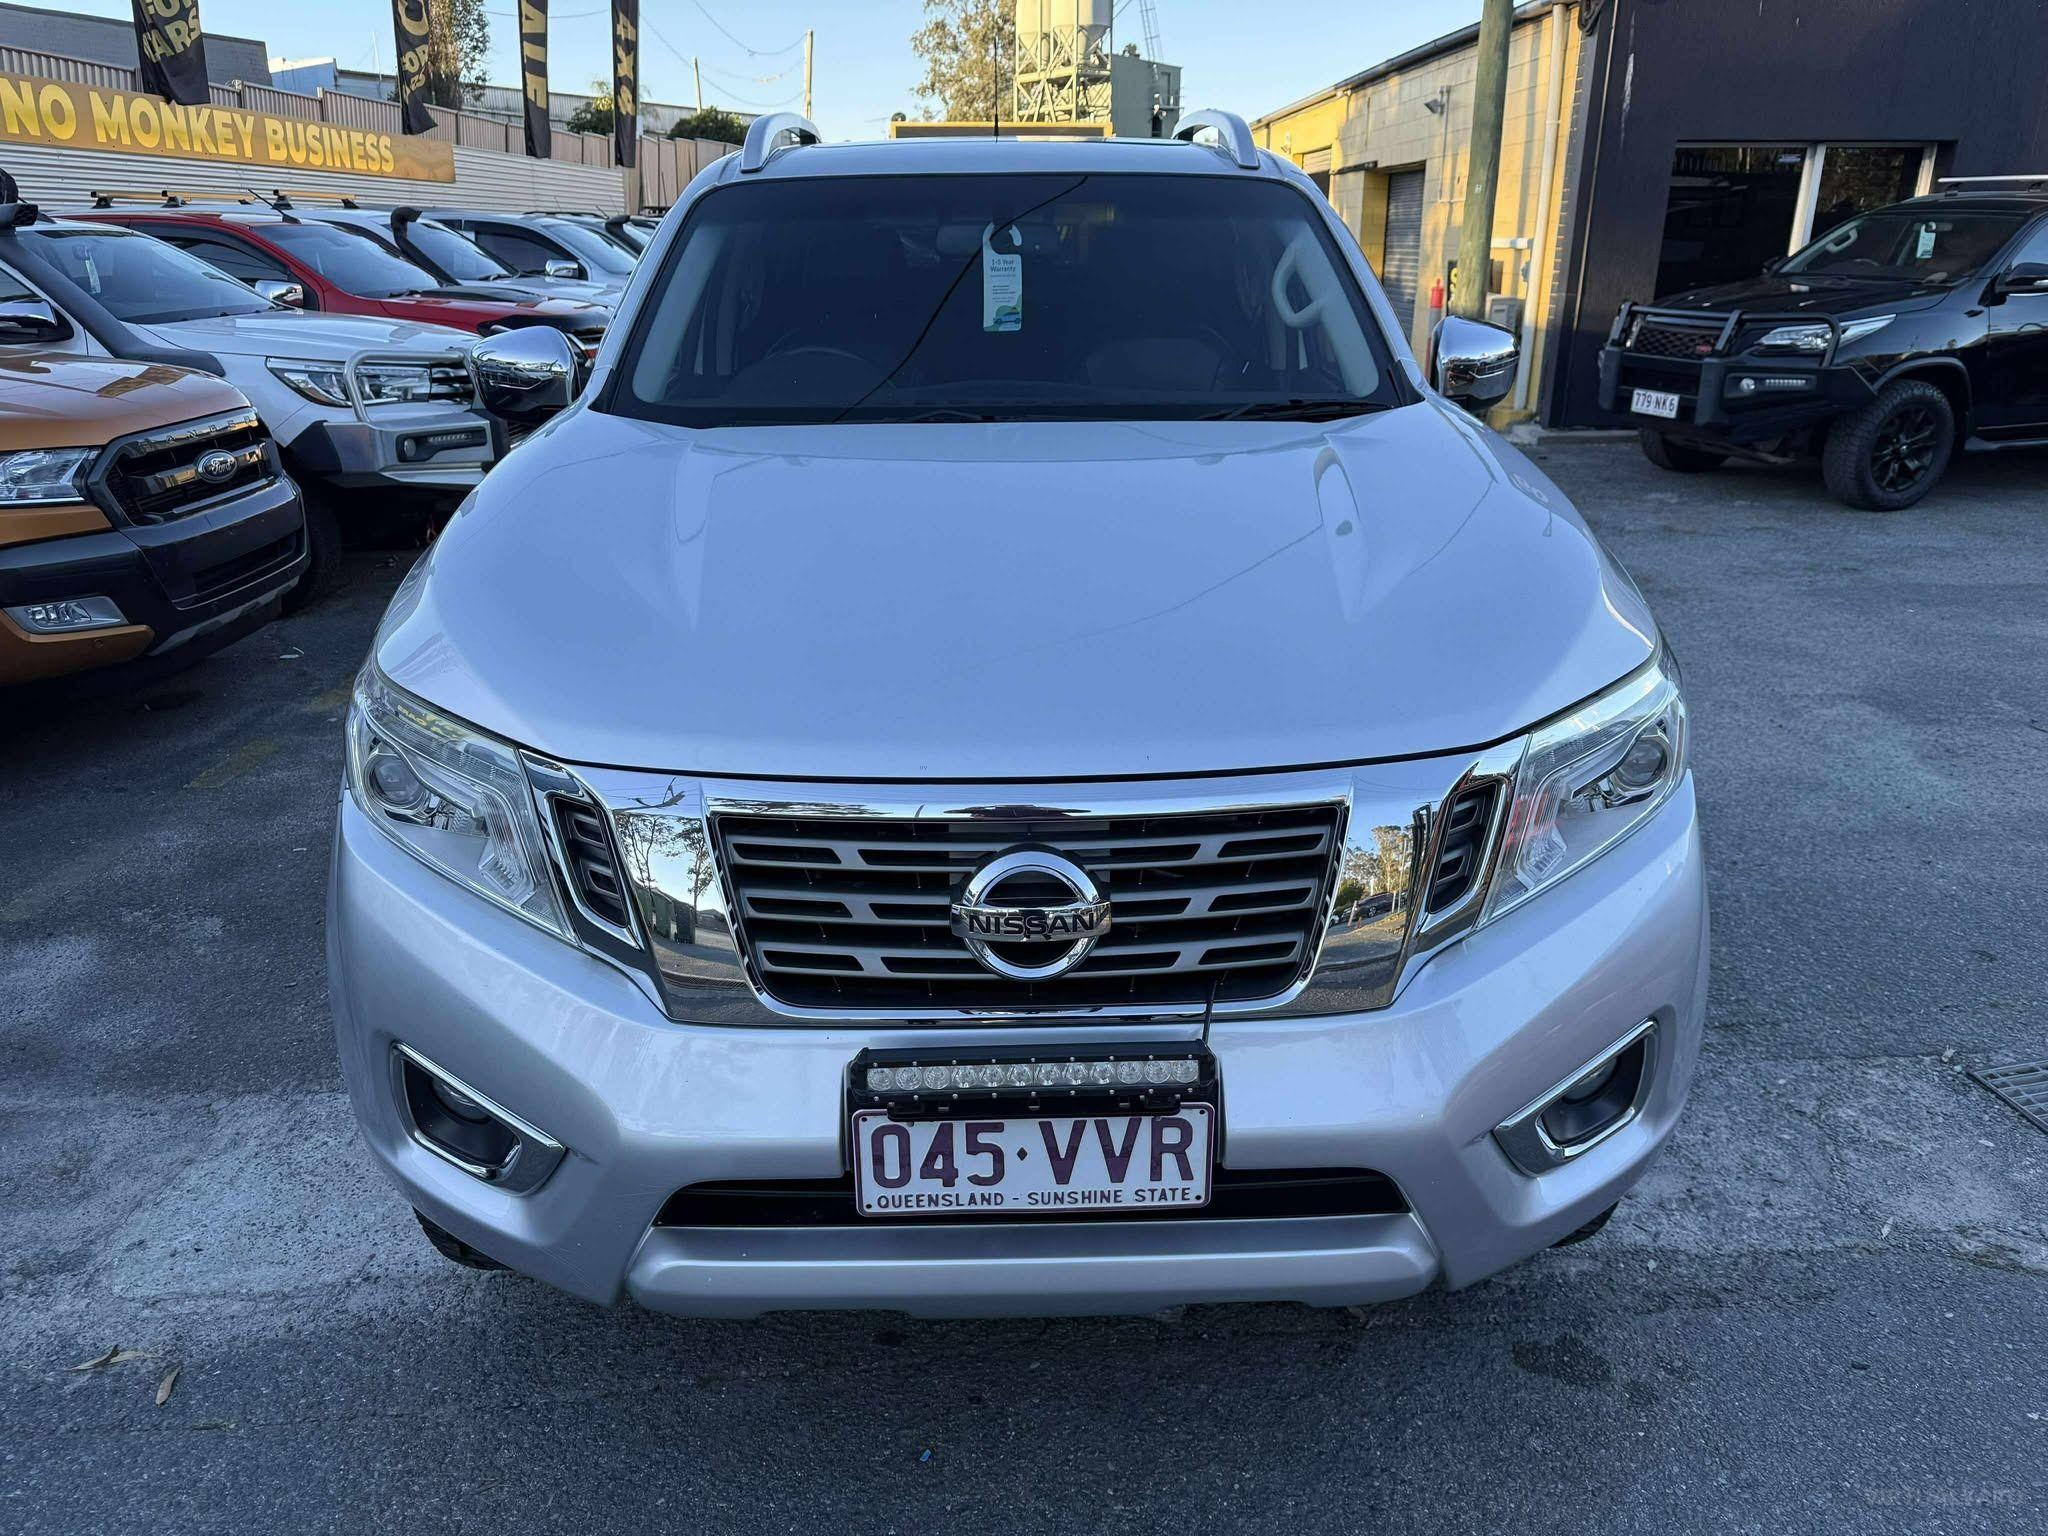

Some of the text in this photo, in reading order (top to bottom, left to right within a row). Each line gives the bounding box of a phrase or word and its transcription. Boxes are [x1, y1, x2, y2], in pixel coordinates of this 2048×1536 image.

[0, 77, 395, 173] NO MONKEY BUSINESS
[208, 457, 234, 476] Ford
[968, 912, 1094, 935] NISSAN
[877, 1193, 1004, 1209] QUEENSLAND
[1027, 1190, 1122, 1206] SUNSHINE
[1134, 1187, 1191, 1203] STATE
